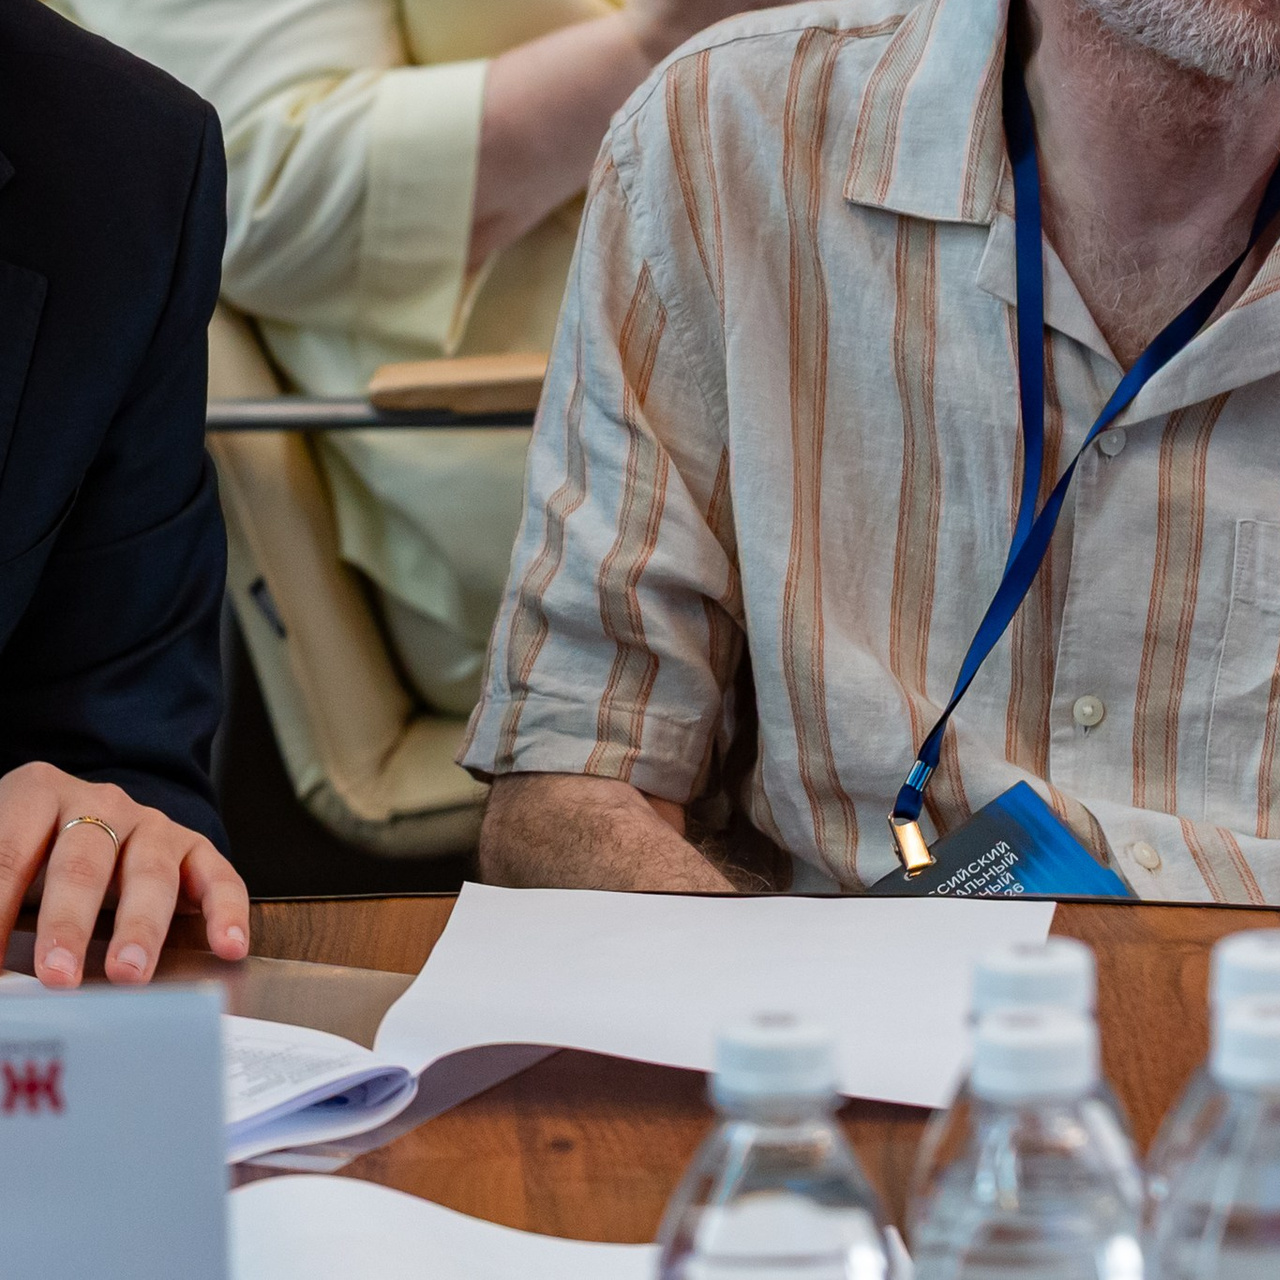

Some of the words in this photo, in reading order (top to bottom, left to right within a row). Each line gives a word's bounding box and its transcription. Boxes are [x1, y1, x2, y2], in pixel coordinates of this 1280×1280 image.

[928, 840, 1011, 895] СИЙСКИЙ
[953, 852, 1019, 896] АЛЬНЫЙ
[977, 871, 1015, 896] НЫЙ
